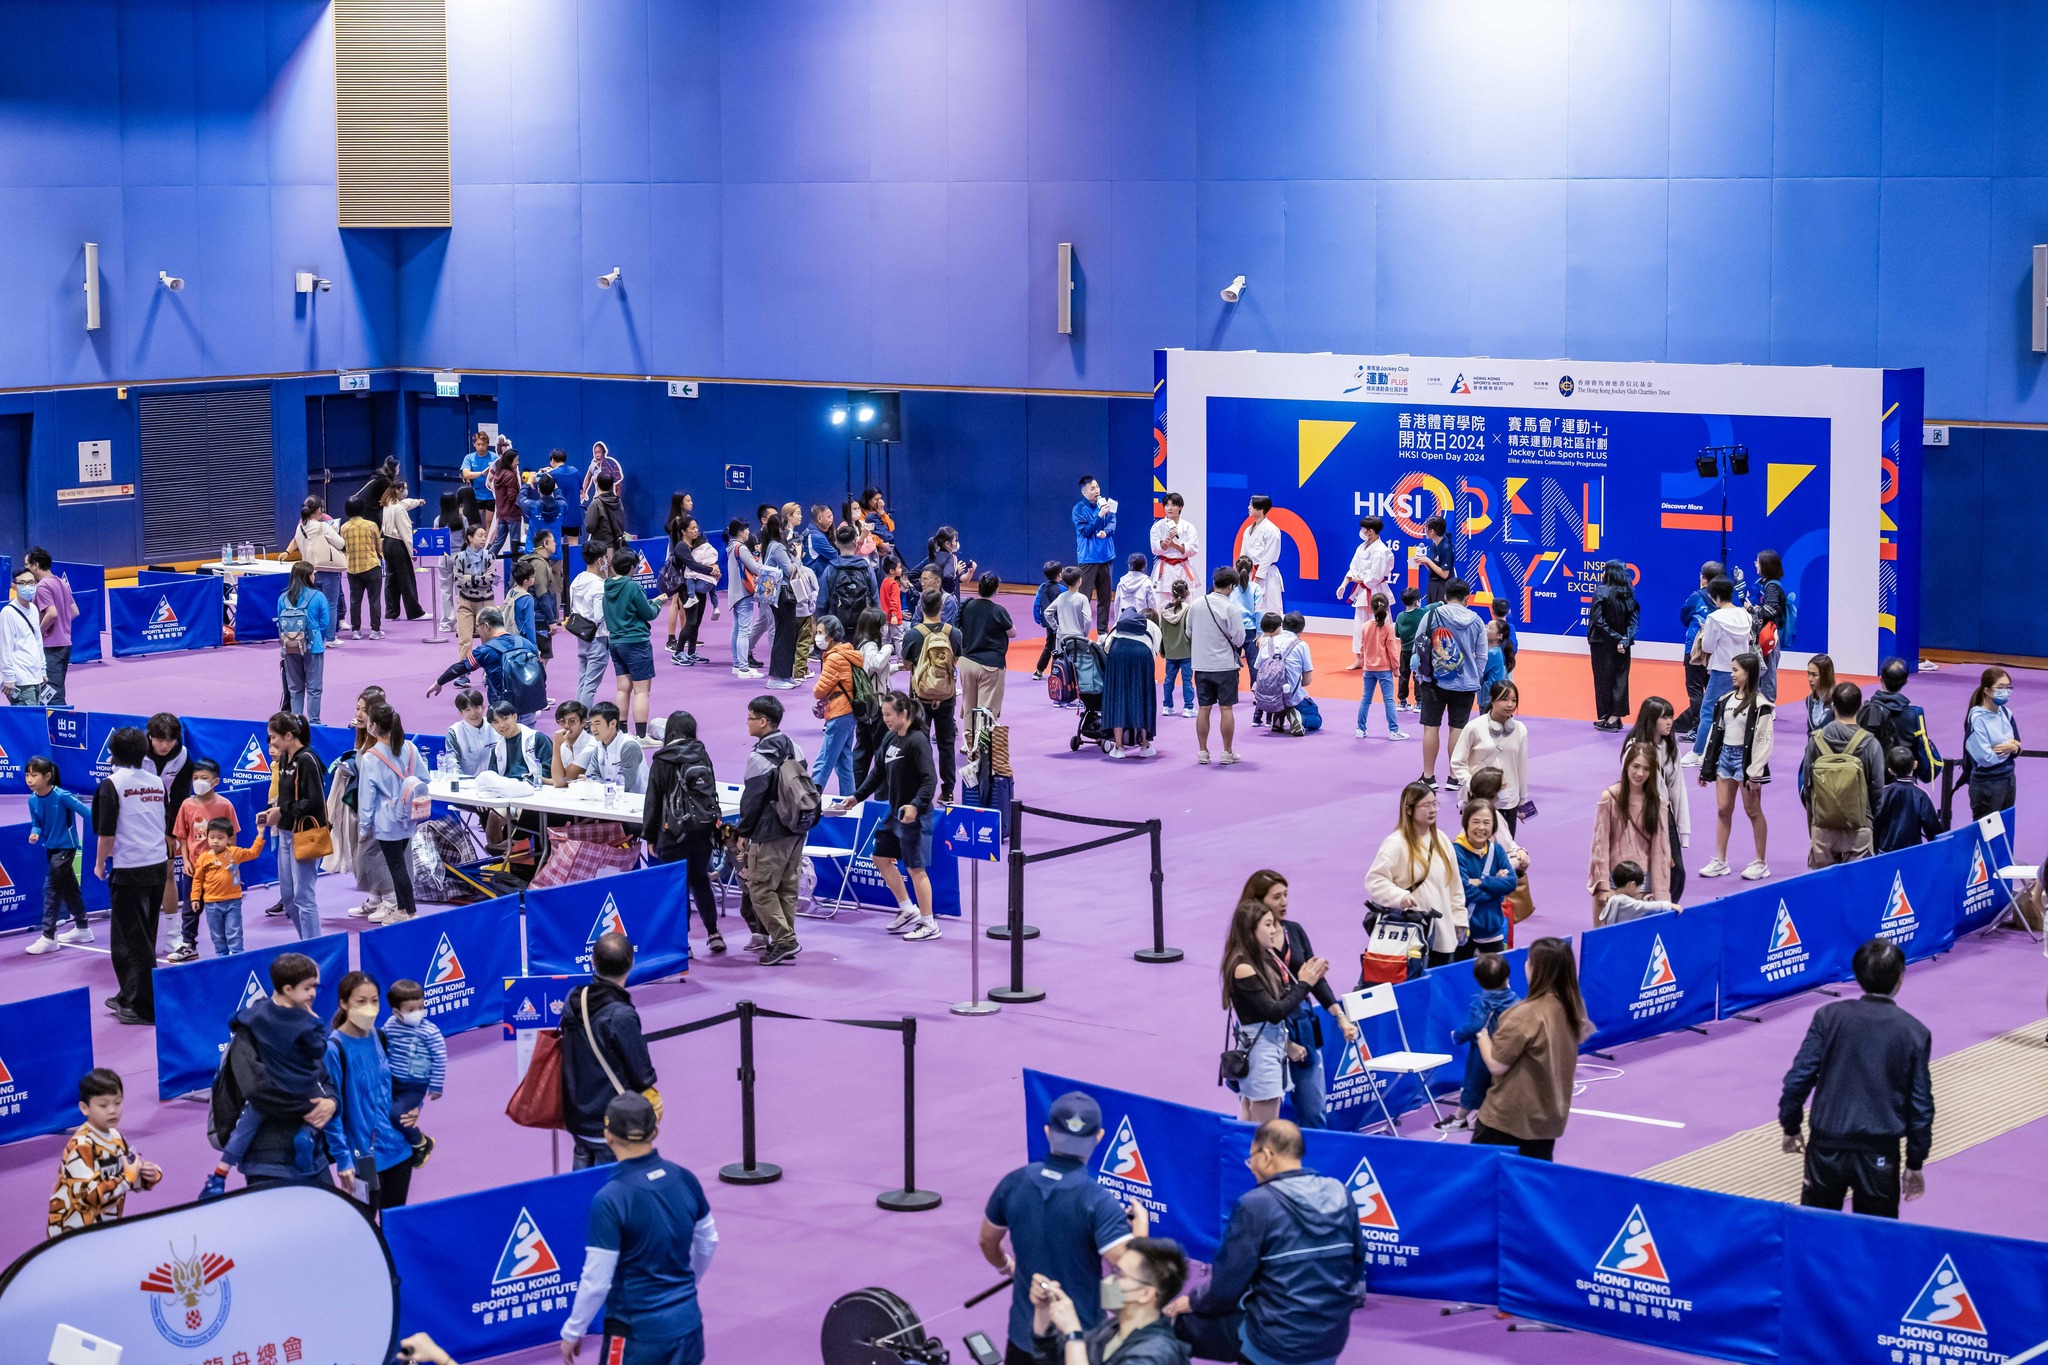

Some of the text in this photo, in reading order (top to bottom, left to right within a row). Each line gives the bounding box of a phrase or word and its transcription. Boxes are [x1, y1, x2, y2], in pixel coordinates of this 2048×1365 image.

[1398, 413, 1485, 431] 香港體育學院
[1399, 431, 1485, 450] 開放日2024
[1508, 435, 1608, 450] 精英運動員社區計劃
[1399, 450, 1485, 462] HKSI Open Day 2024
[1508, 449, 1608, 460] Jockey Club Sports PLUS
[1354, 492, 1422, 518] HKSI
[1584, 561, 1605, 570] INSP
[58, 718, 76, 731] 出口
[424, 981, 465, 998] HONG KONG
[424, 986, 475, 1006] ORTS INSTITUTE
[0, 1085, 14, 1094] NG
[1333, 1078, 1354, 1091] HONG
[1325, 1090, 1350, 1101] PORTS
[1097, 1175, 1125, 1190] HONG
[1126, 1183, 1153, 1198] KONG
[1362, 1229, 1399, 1243] KONG
[1367, 1242, 1420, 1256] STITUTE
[491, 1274, 560, 1298] HONG KONG
[1594, 1272, 1671, 1295] HONG KONG
[472, 1281, 578, 1313] SPORTS INSTITUTE
[1576, 1279, 1692, 1311] SPORTS INSTITUTE
[1877, 1334, 1935, 1352] SPORTS
[1900, 1325, 1988, 1348] HONG KONG
